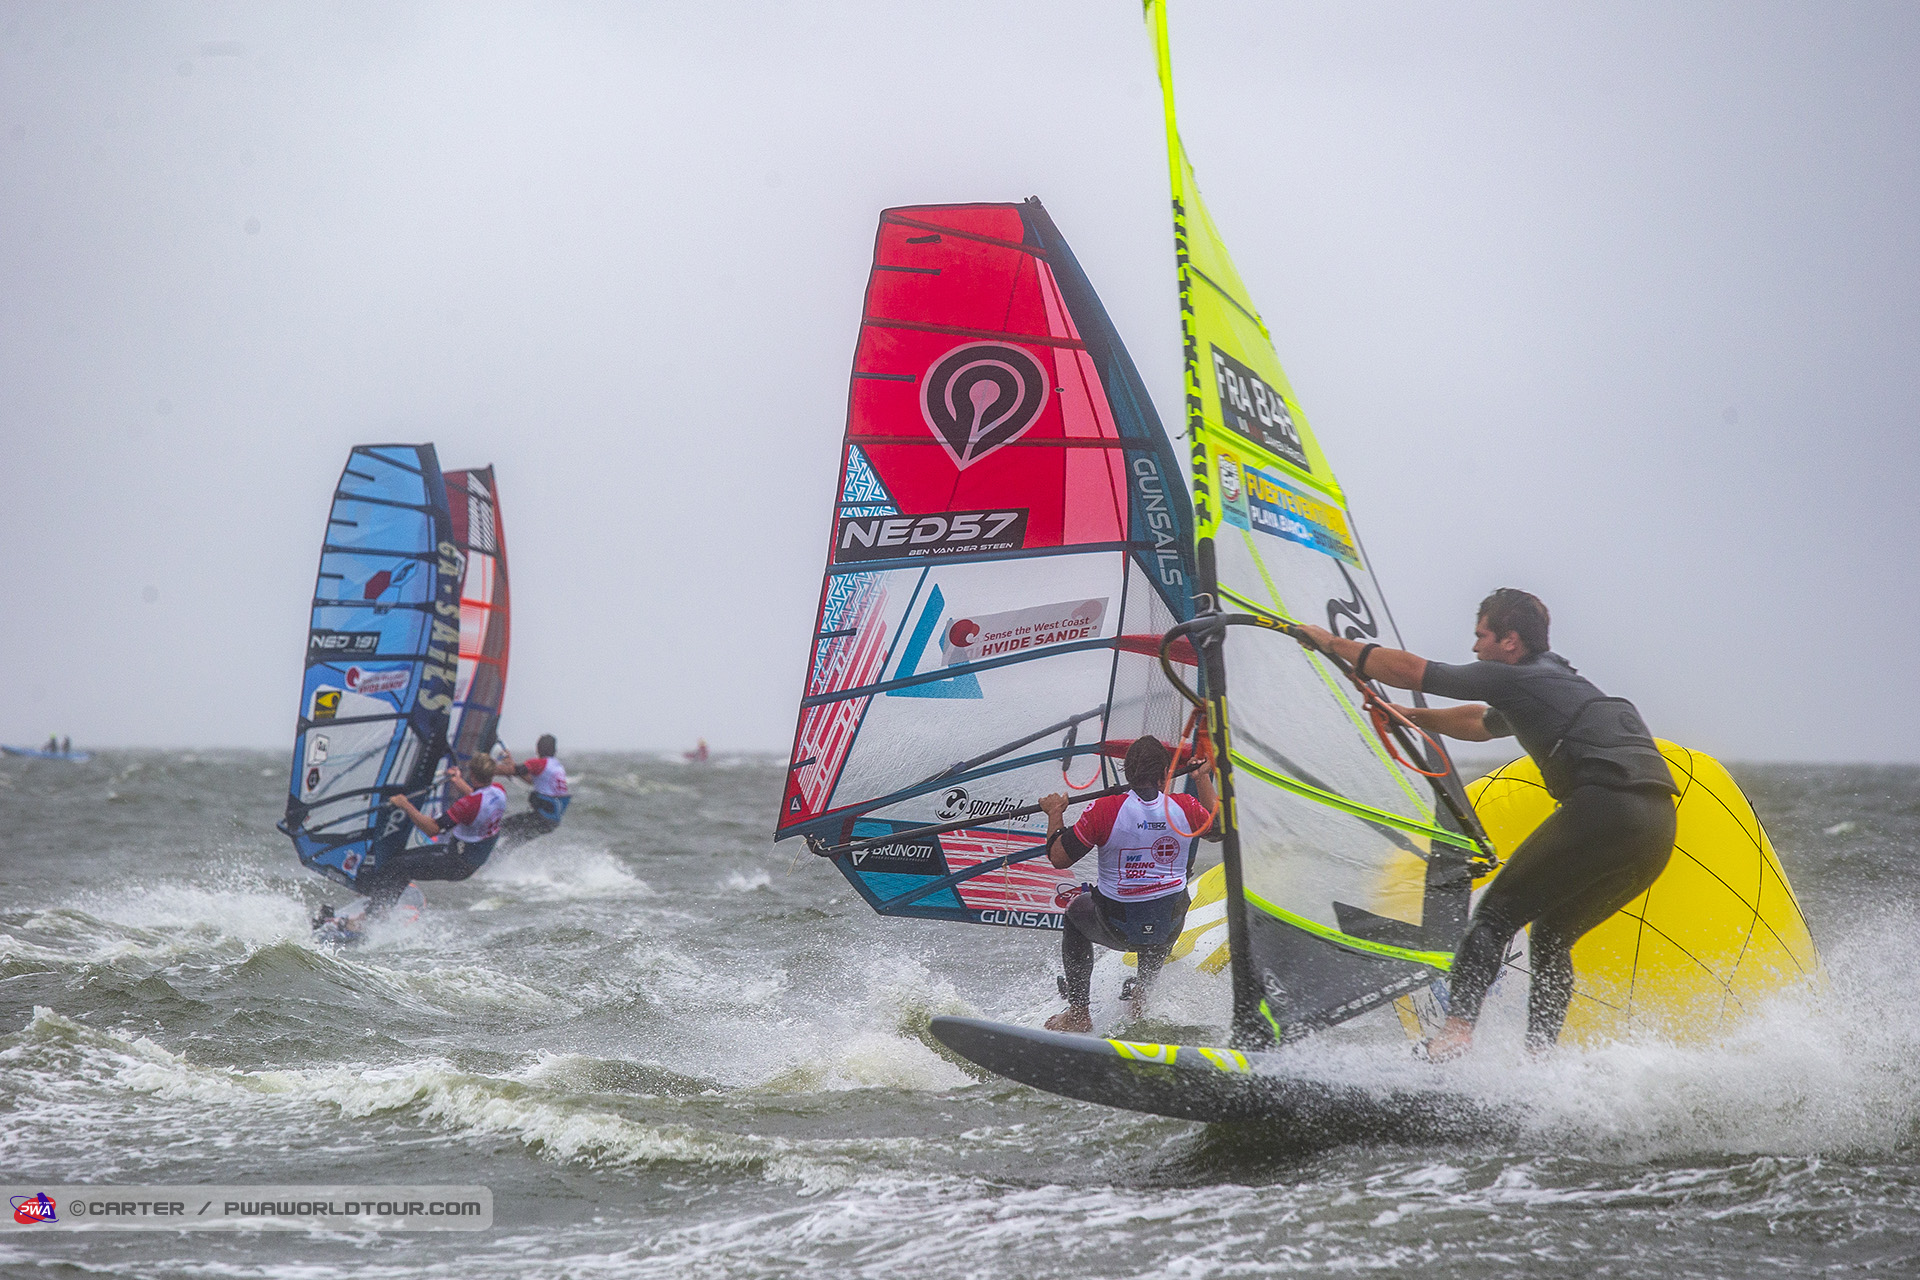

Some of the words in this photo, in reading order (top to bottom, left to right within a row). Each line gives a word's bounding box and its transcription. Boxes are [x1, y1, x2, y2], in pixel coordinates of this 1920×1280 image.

[1212, 351, 1256, 418] FRA
[841, 512, 1019, 549] NED57
[1133, 458, 1183, 586] GUNSAILS
[908, 548, 930, 557] BEN
[932, 547, 956, 555] VAN
[956, 544, 978, 552] DER
[979, 542, 1014, 551] STEEN
[310, 634, 350, 649] NED
[354, 635, 379, 649] 191
[981, 636, 1032, 657] HVIDE
[1033, 627, 1091, 646] SANDE
[983, 632, 1013, 642] Sense
[1015, 625, 1032, 635] the
[1033, 621, 1059, 632] West
[1061, 616, 1090, 627] Coast
[871, 843, 933, 859] BRUNOTTI
[1126, 854, 1142, 862] WE
